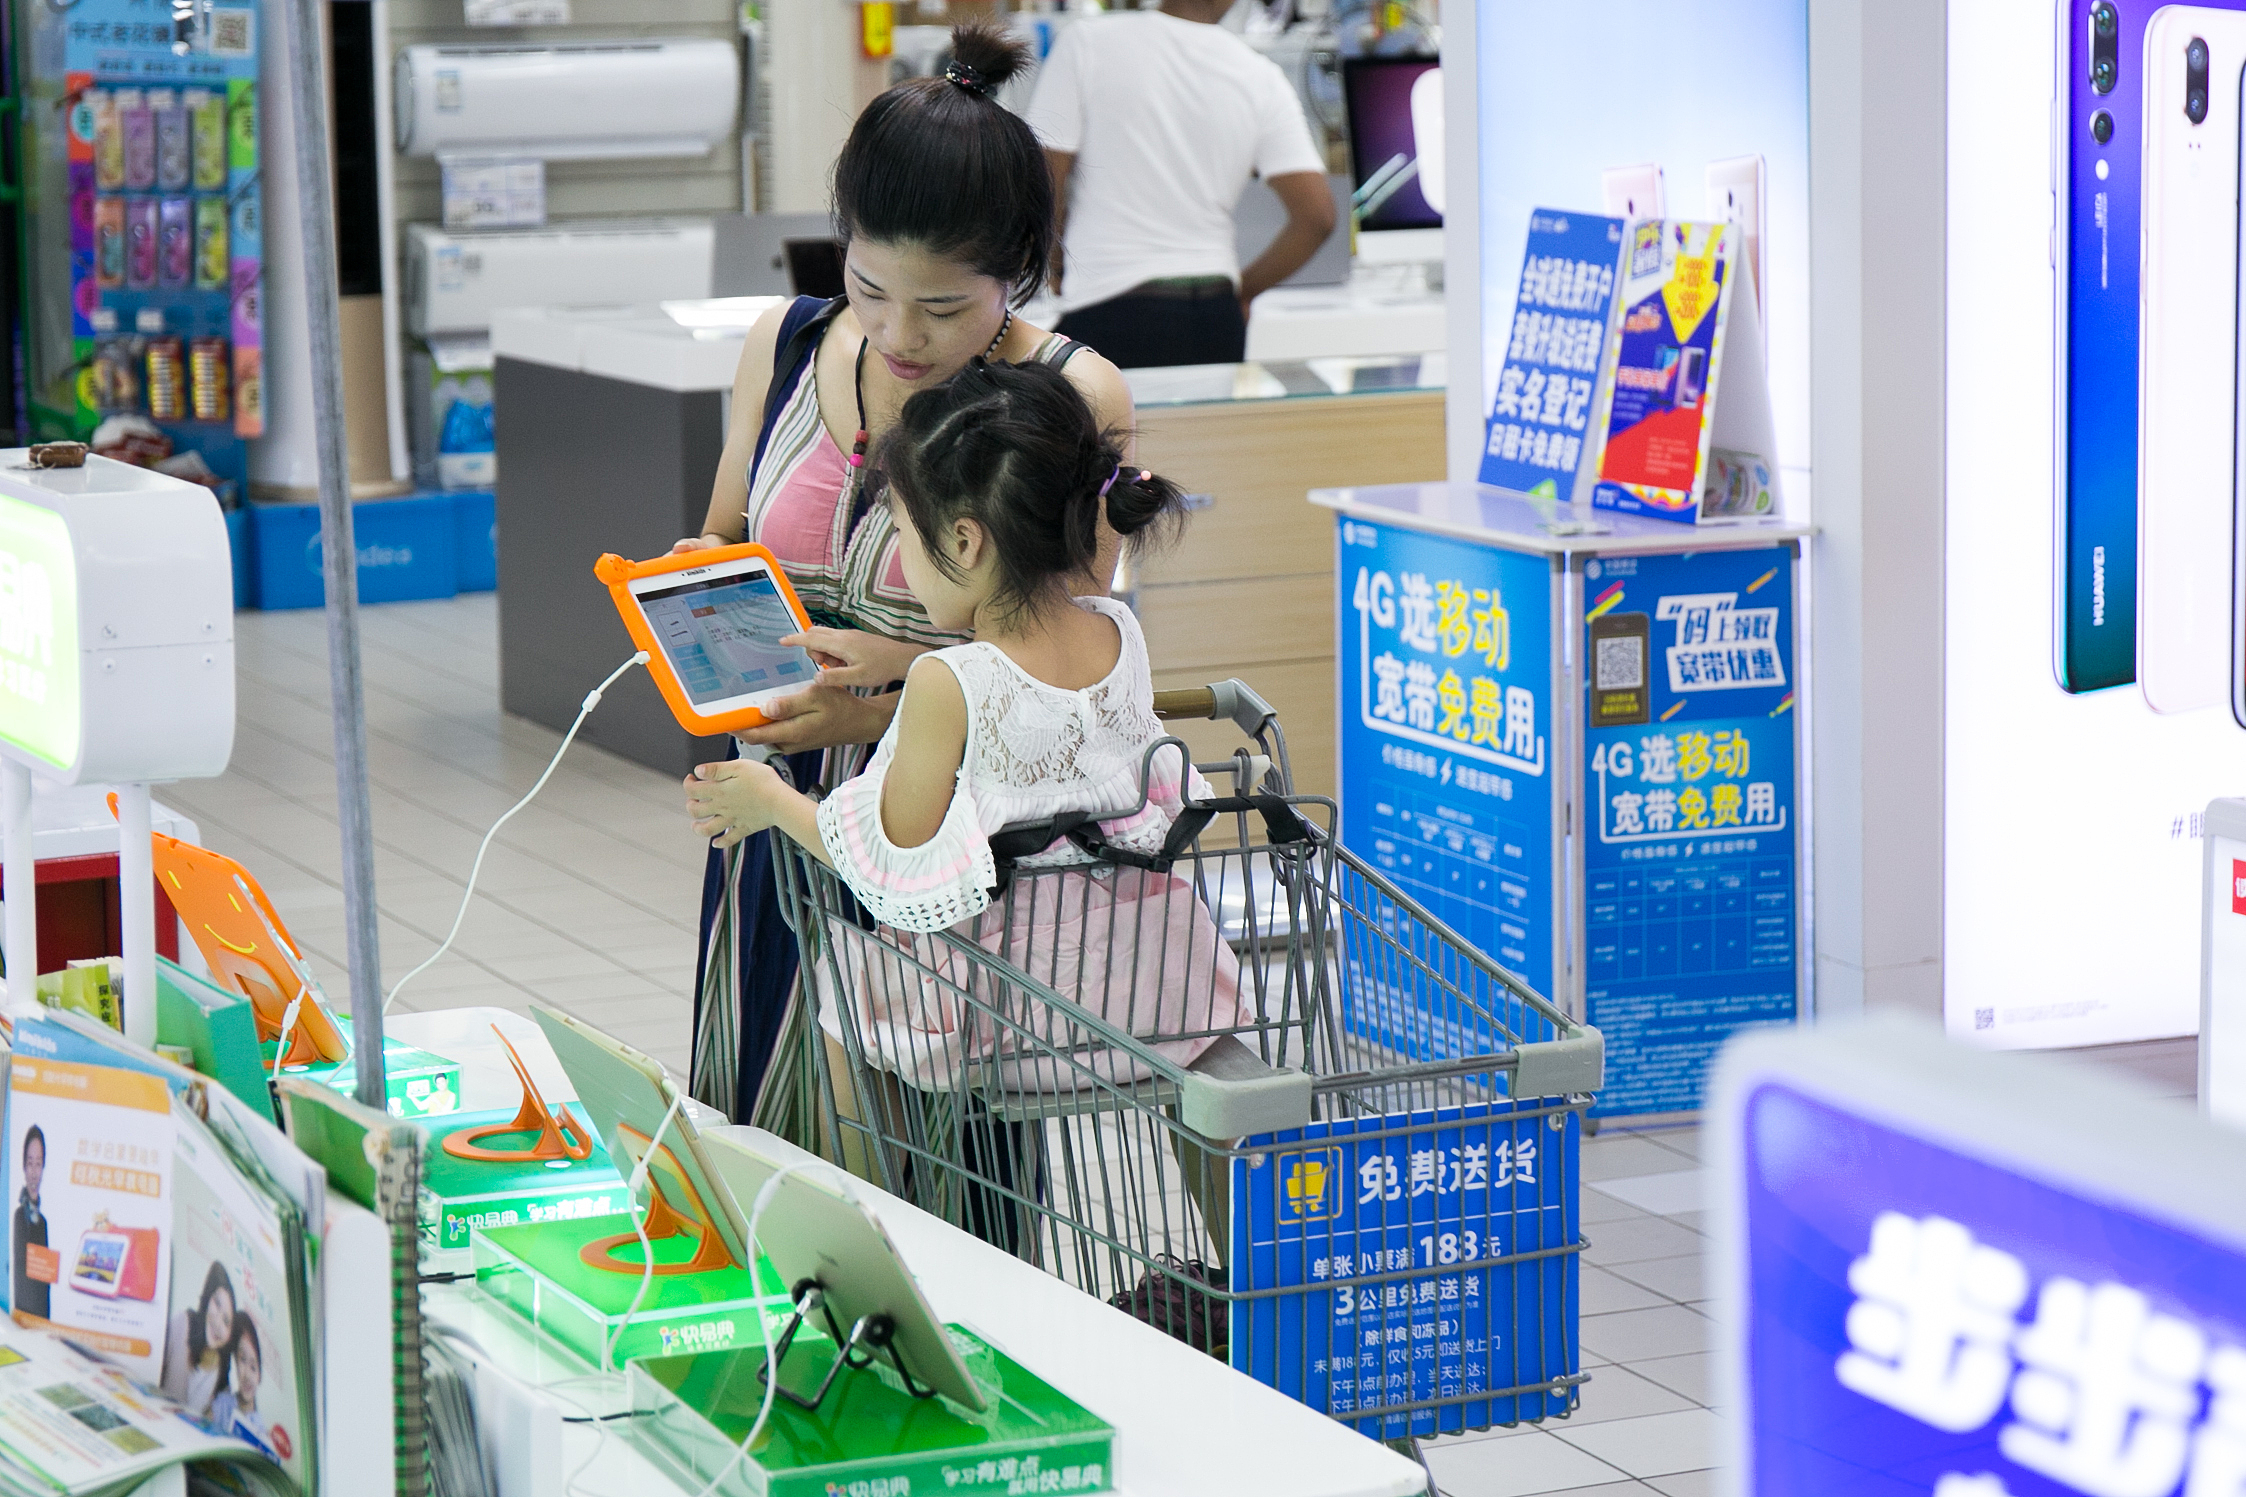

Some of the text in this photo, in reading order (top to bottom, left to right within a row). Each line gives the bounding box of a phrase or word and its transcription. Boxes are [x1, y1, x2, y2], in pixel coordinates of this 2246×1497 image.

[1495, 364, 1592, 431] 实名登记
[2093, 545, 2106, 626] HUAWEI
[1675, 648, 1776, 685] 宽带优惠
[1373, 651, 1536, 760] 宽带免费用
[1592, 729, 1750, 785] 4G选移动
[1612, 781, 1776, 835] 宽带免费用
[1358, 1138, 1537, 1205] 免费送货
